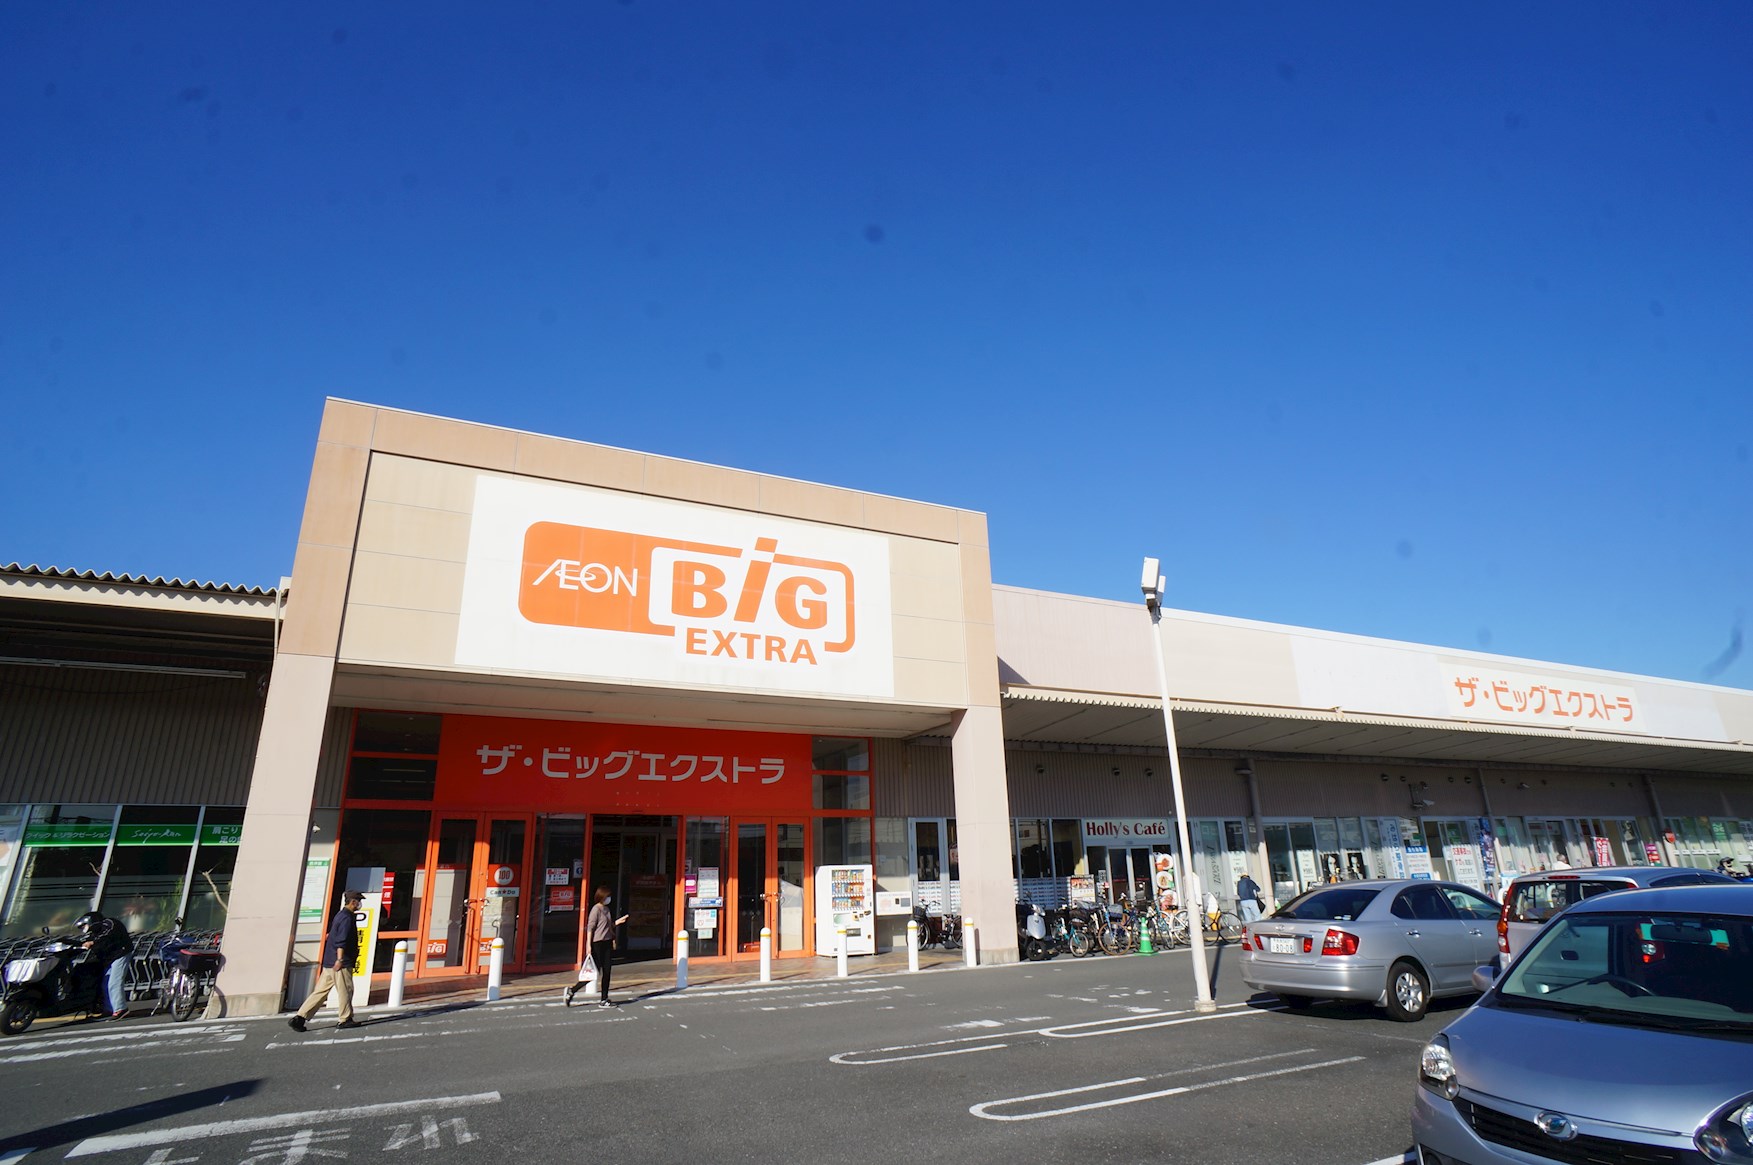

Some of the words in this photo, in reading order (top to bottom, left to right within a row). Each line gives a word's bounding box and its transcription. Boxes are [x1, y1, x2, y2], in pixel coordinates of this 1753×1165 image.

[685, 628, 818, 666] EXTRA
[1454, 676, 1634, 722] ザ・ビッグエクストラ
[476, 744, 786, 785] ザ・ビッグエクストラ
[212, 826, 239, 835] 肩こり
[1086, 822, 1130, 838] Holly's
[1134, 821, 1166, 836] Café
[498, 870, 510, 880] 100
